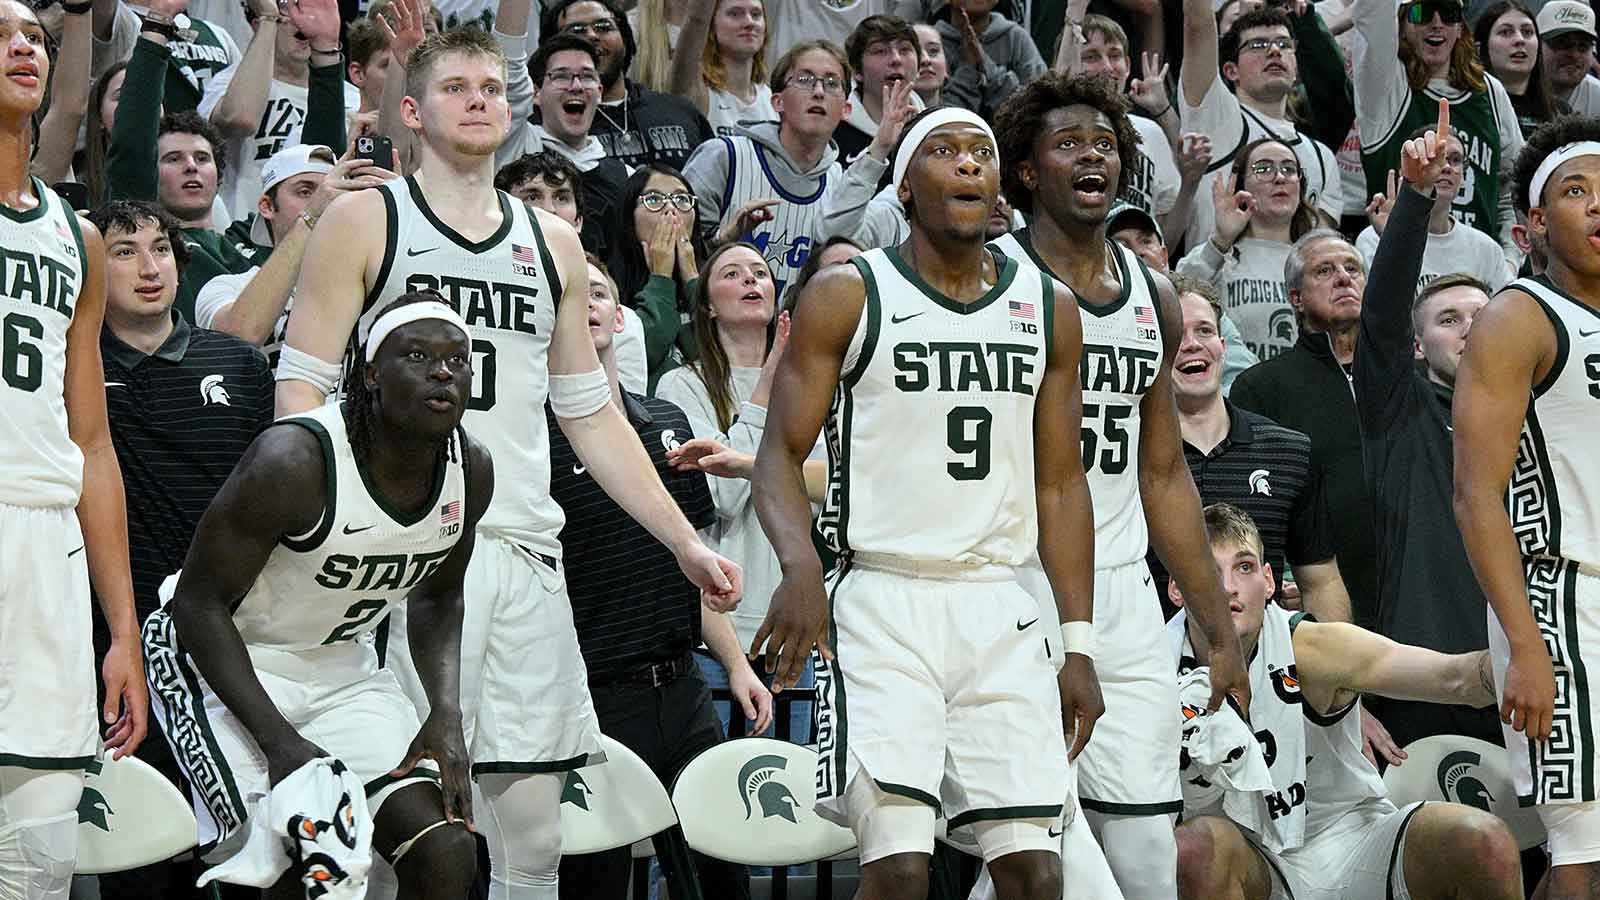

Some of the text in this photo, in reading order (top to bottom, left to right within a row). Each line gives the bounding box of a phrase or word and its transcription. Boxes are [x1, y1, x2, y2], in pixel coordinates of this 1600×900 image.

[1010, 320, 1037, 334] B1G
[893, 342, 1039, 396] STATE
[947, 406, 993, 480] 9
[321, 599, 388, 645] 2
